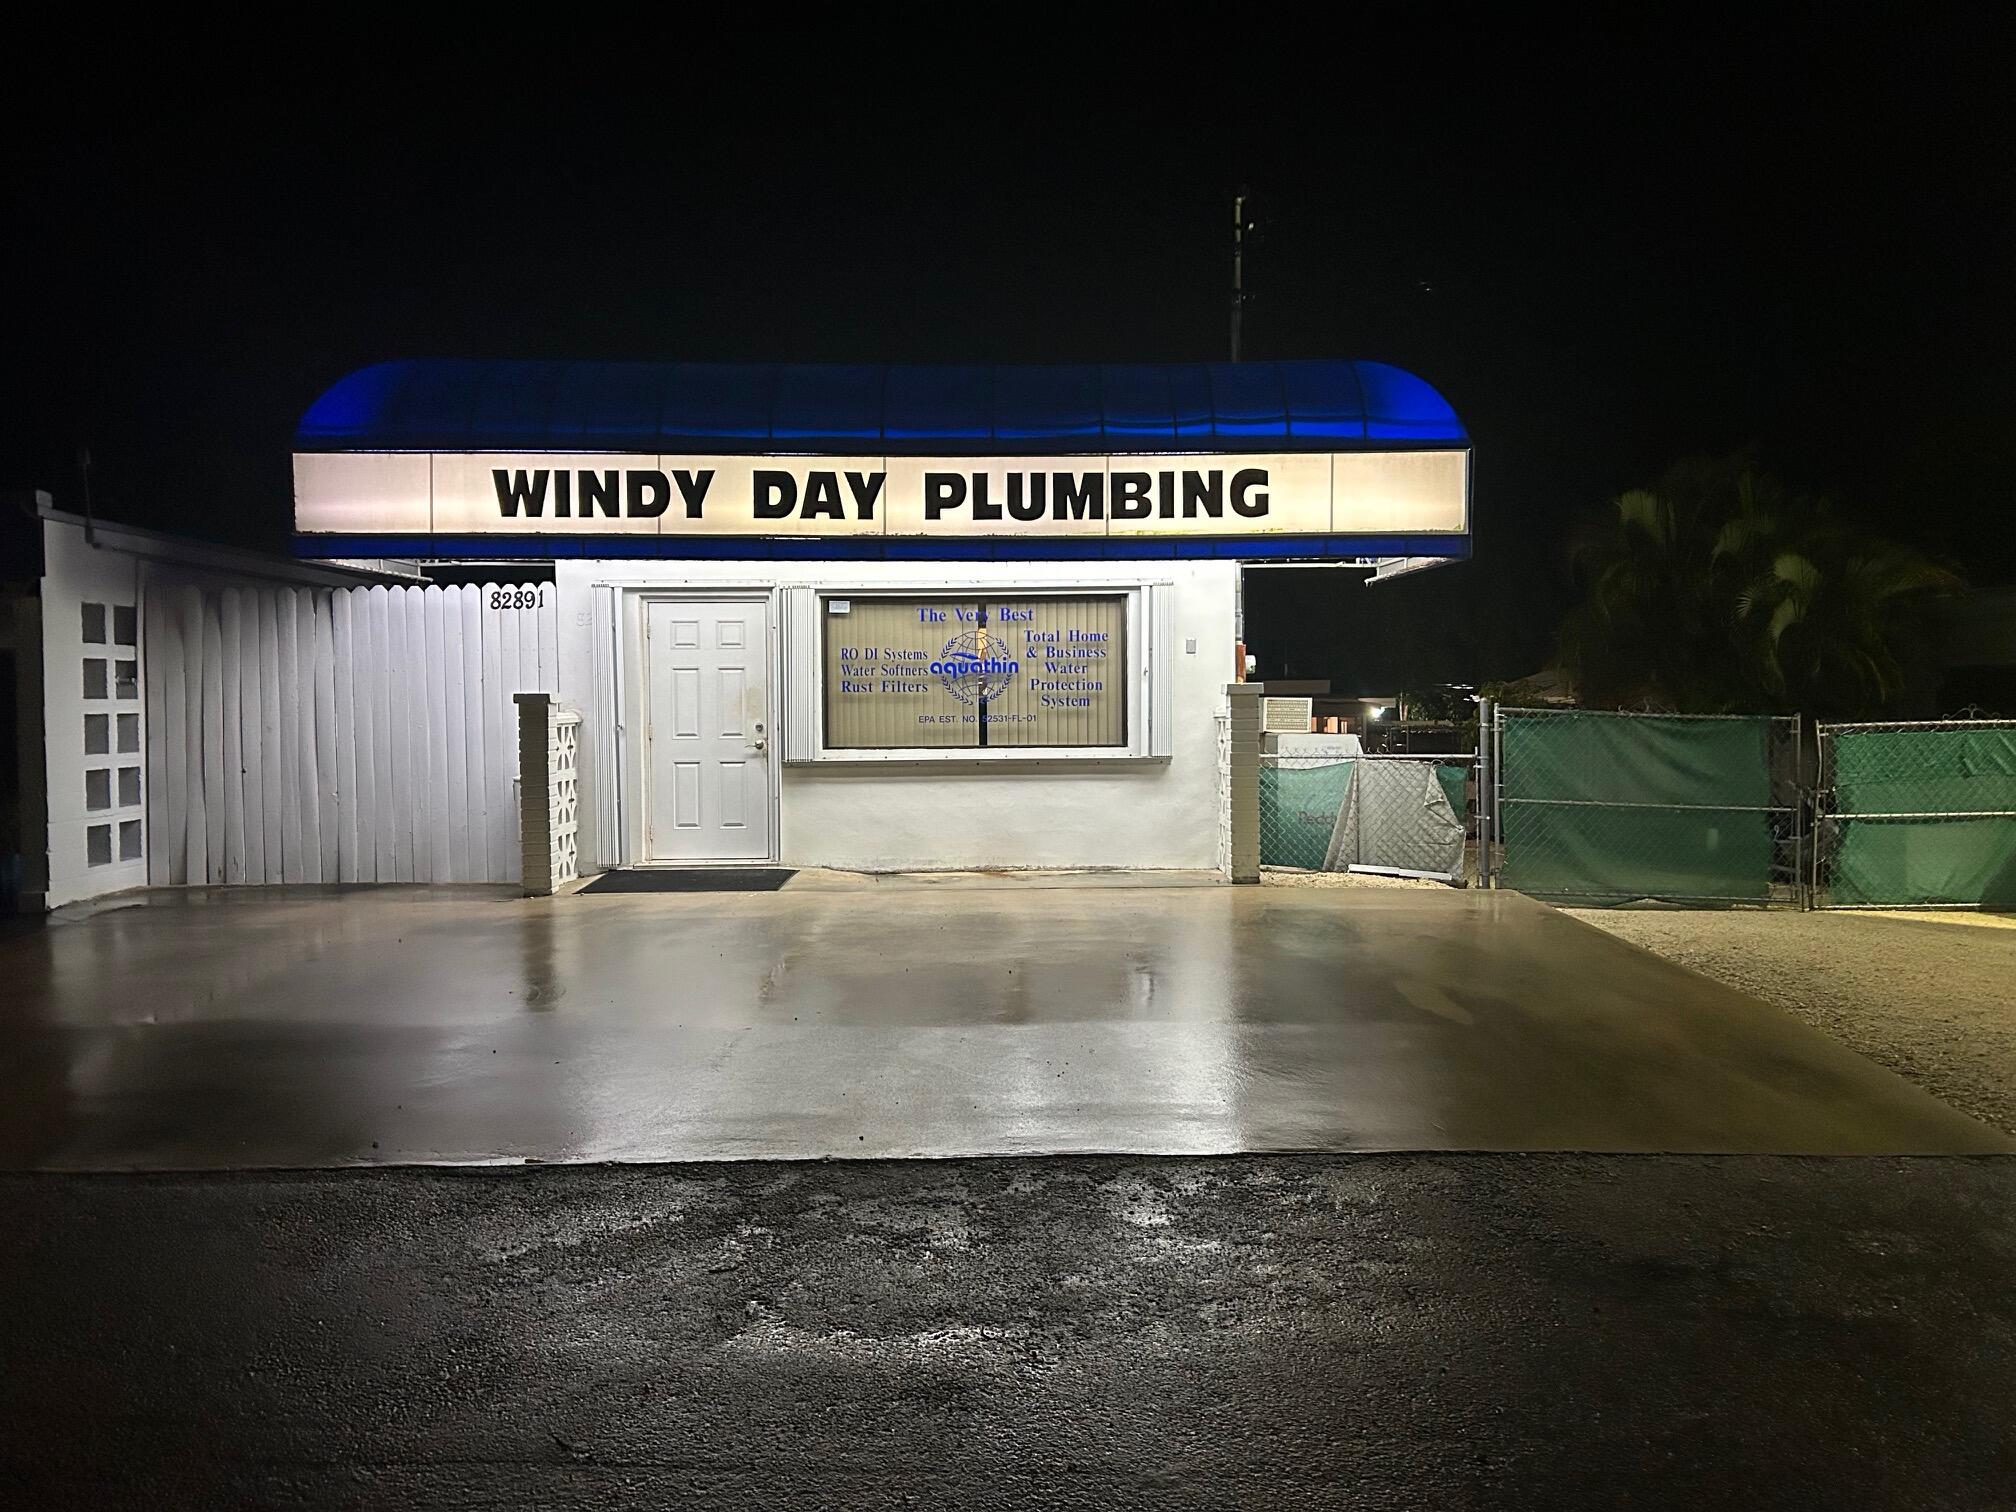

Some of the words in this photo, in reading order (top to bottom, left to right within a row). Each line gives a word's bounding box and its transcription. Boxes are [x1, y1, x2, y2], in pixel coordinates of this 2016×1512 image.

[492, 469, 716, 519] WINDY
[753, 470, 887, 520] DAY
[924, 468, 1269, 521] PLUMBING
[490, 589, 544, 610] 82891
[916, 607, 947, 623] The
[955, 607, 991, 625] Very
[999, 607, 1034, 622] Best
[1024, 629, 1060, 643] Total
[1068, 629, 1109, 642] Home
[841, 648, 859, 660] RO
[865, 648, 878, 660] DI
[884, 647, 928, 662] Systems
[1026, 646, 1037, 659] &
[1046, 645, 1107, 659] Business
[841, 664, 875, 677] Water
[881, 663, 929, 677] Softners
[930, 657, 1019, 679] aquathin
[1045, 662, 1088, 674] Water
[841, 680, 873, 693] Rust
[881, 680, 928, 693] Filters
[1030, 678, 1103, 691] Protection
[1041, 694, 1090, 709] System
[918, 715, 936, 723] EPA
